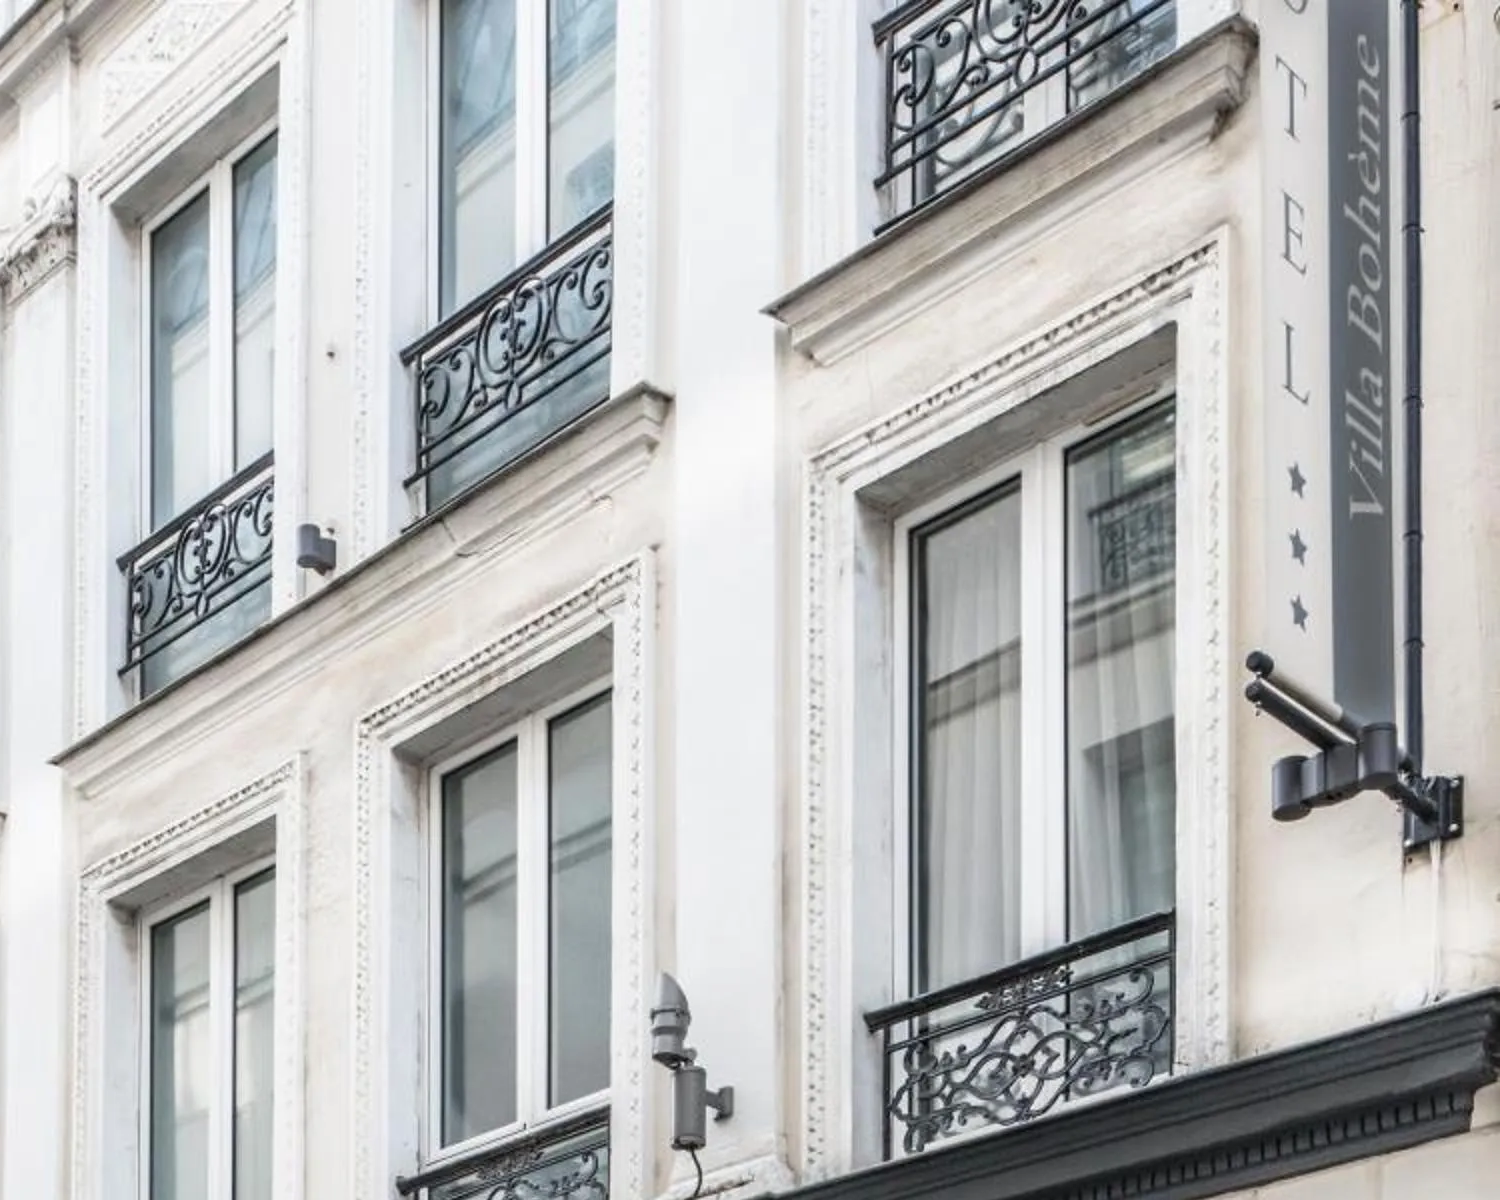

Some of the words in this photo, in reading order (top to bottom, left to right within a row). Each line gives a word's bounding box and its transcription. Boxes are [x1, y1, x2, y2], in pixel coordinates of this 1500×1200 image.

[1275, 0, 1309, 407] TEL
[1343, 34, 1383, 353] Bohème
[1344, 366, 1384, 520] Villa
